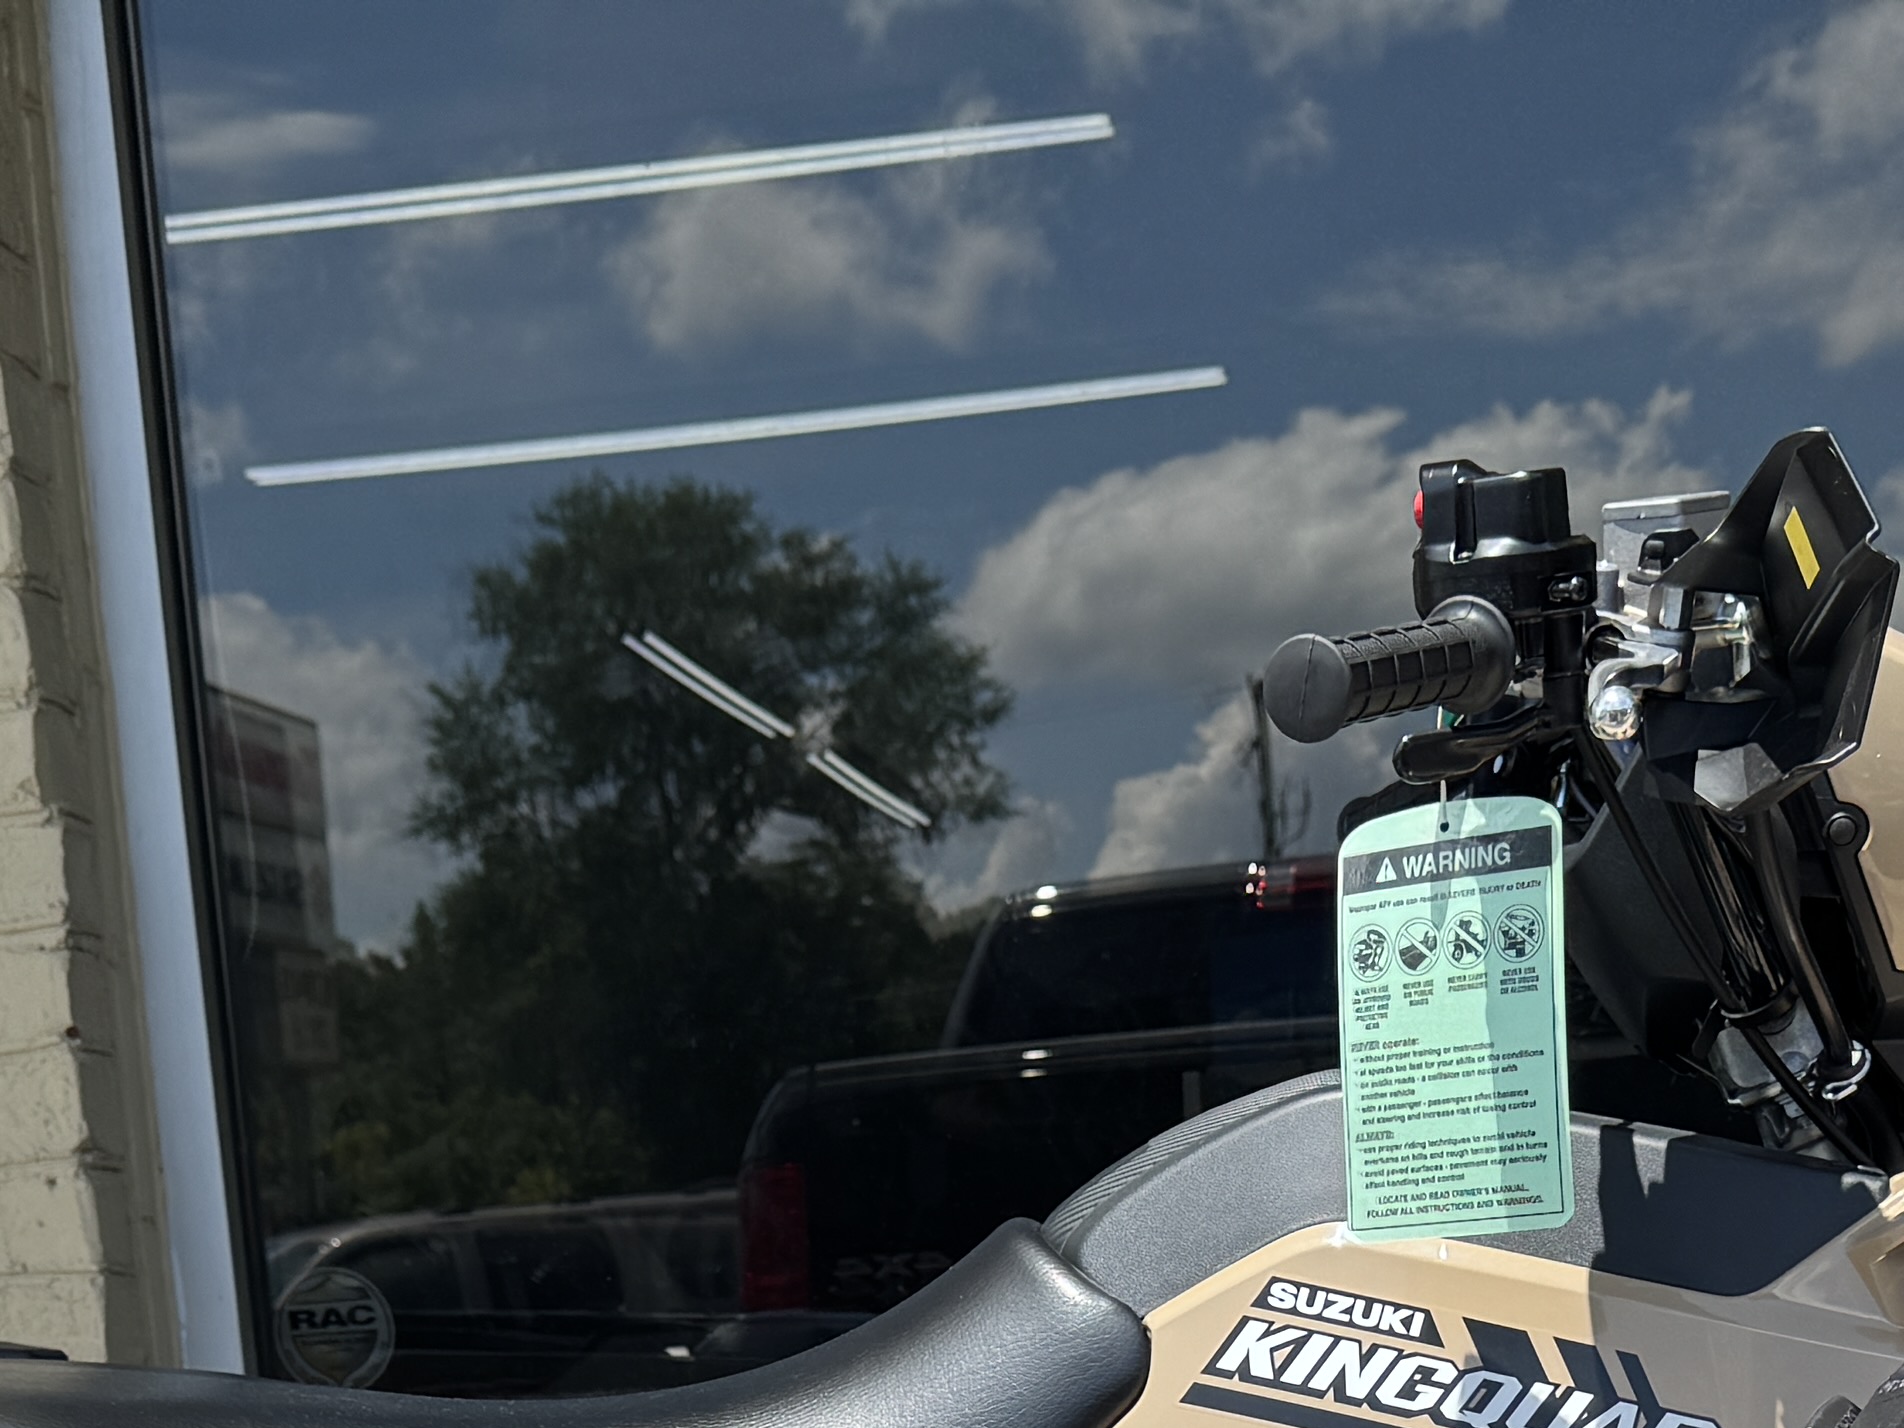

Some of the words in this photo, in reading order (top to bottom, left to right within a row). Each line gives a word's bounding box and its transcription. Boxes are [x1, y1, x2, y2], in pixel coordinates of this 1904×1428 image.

[1402, 842, 1511, 879] WARNING
[1516, 880, 1541, 890] DEATH
[290, 1306, 375, 1329] RAC
[1267, 1280, 1425, 1338] SUZUKI
